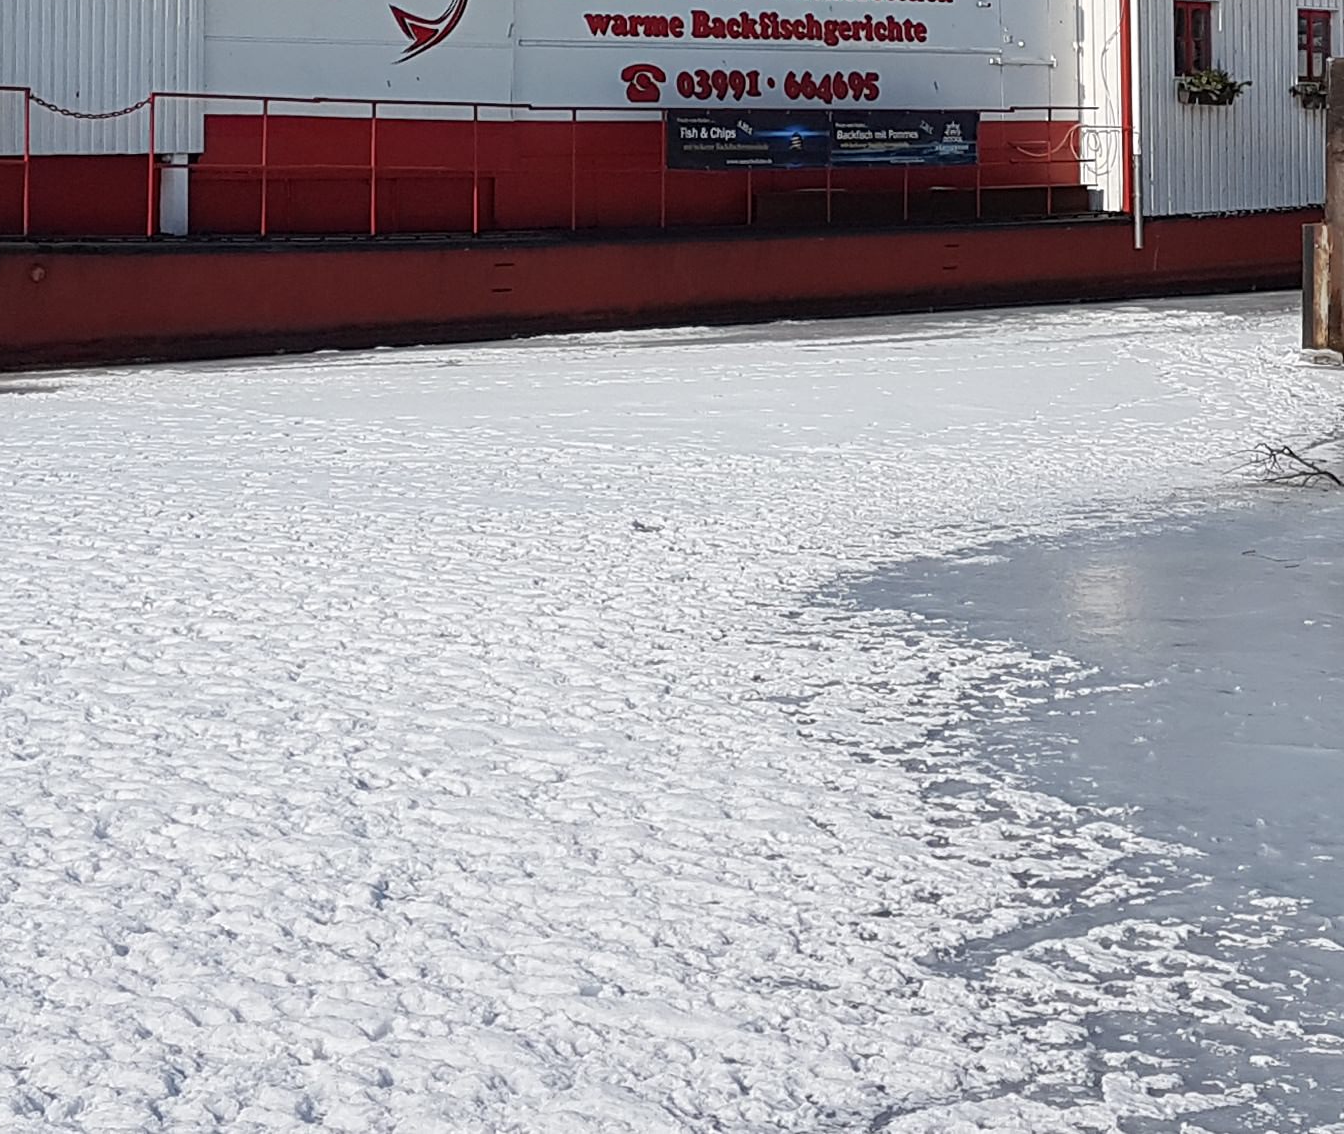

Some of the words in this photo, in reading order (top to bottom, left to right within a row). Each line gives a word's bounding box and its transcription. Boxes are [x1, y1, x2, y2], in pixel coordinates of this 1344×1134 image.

[583, 13, 685, 38] warme
[690, 9, 928, 47] Backfischgerichte
[676, 69, 762, 102] 03991
[783, 70, 880, 105] 664695
[680, 126, 698, 139] Fish
[699, 127, 708, 139] &
[709, 126, 736, 141] Chips
[836, 129, 873, 141] Backfisch
